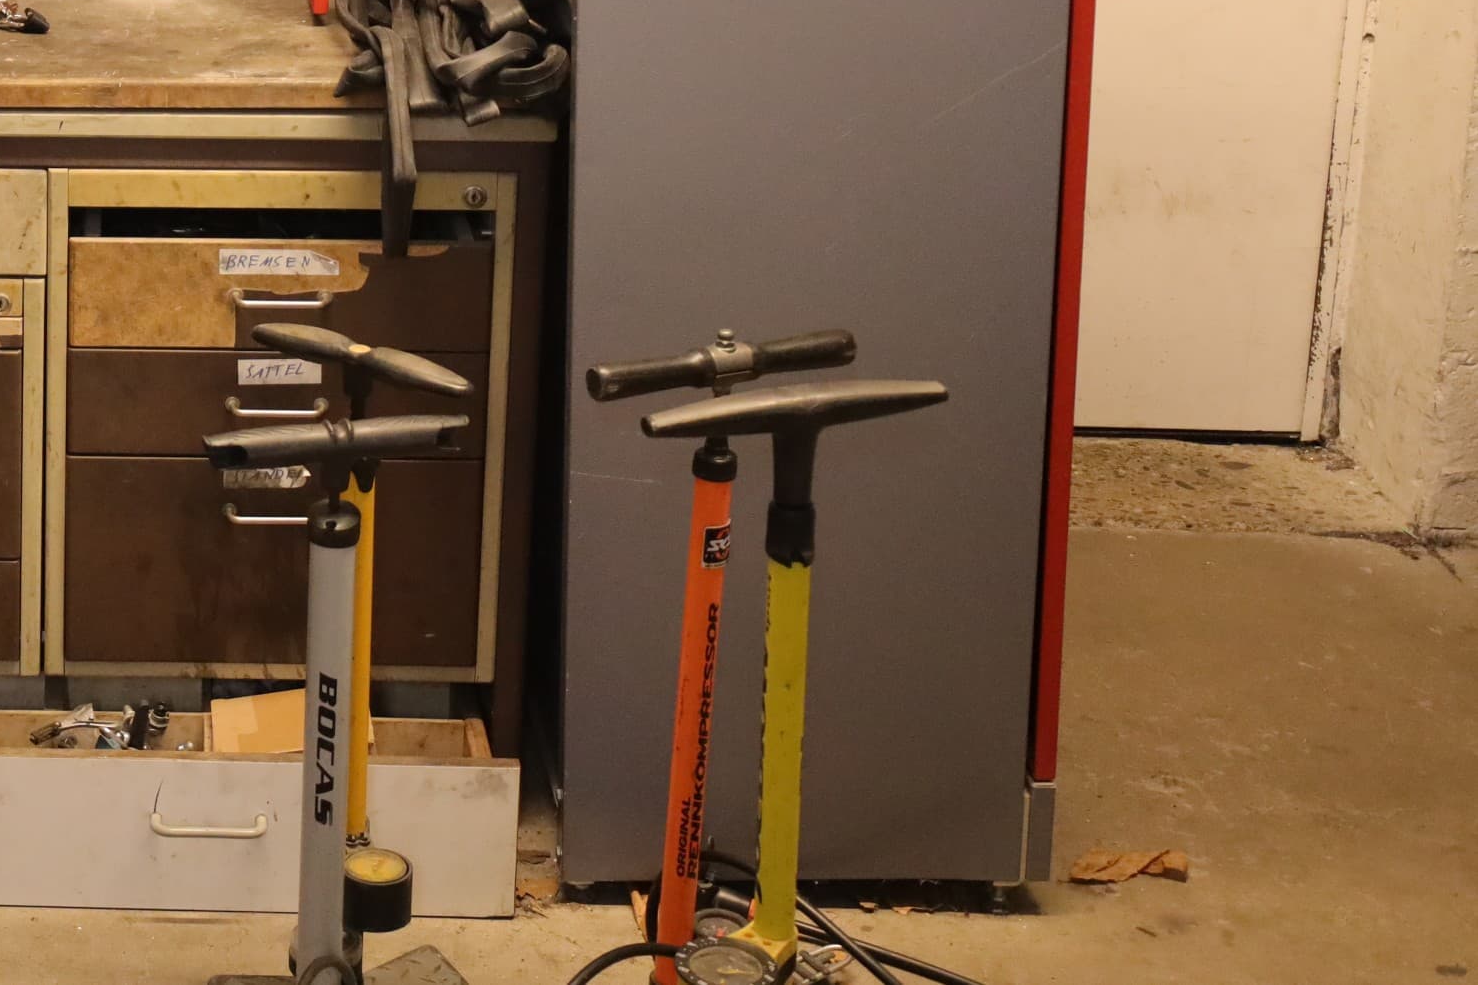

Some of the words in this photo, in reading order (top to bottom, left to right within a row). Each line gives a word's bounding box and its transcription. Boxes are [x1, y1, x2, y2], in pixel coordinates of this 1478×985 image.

[225, 254, 311, 271] BREMSEN
[245, 362, 305, 379] SATTEL
[314, 671, 338, 827] BOCAS
[687, 603, 720, 880] RENNKOMPRESSOR
[675, 797, 691, 878] ORIGINAL
